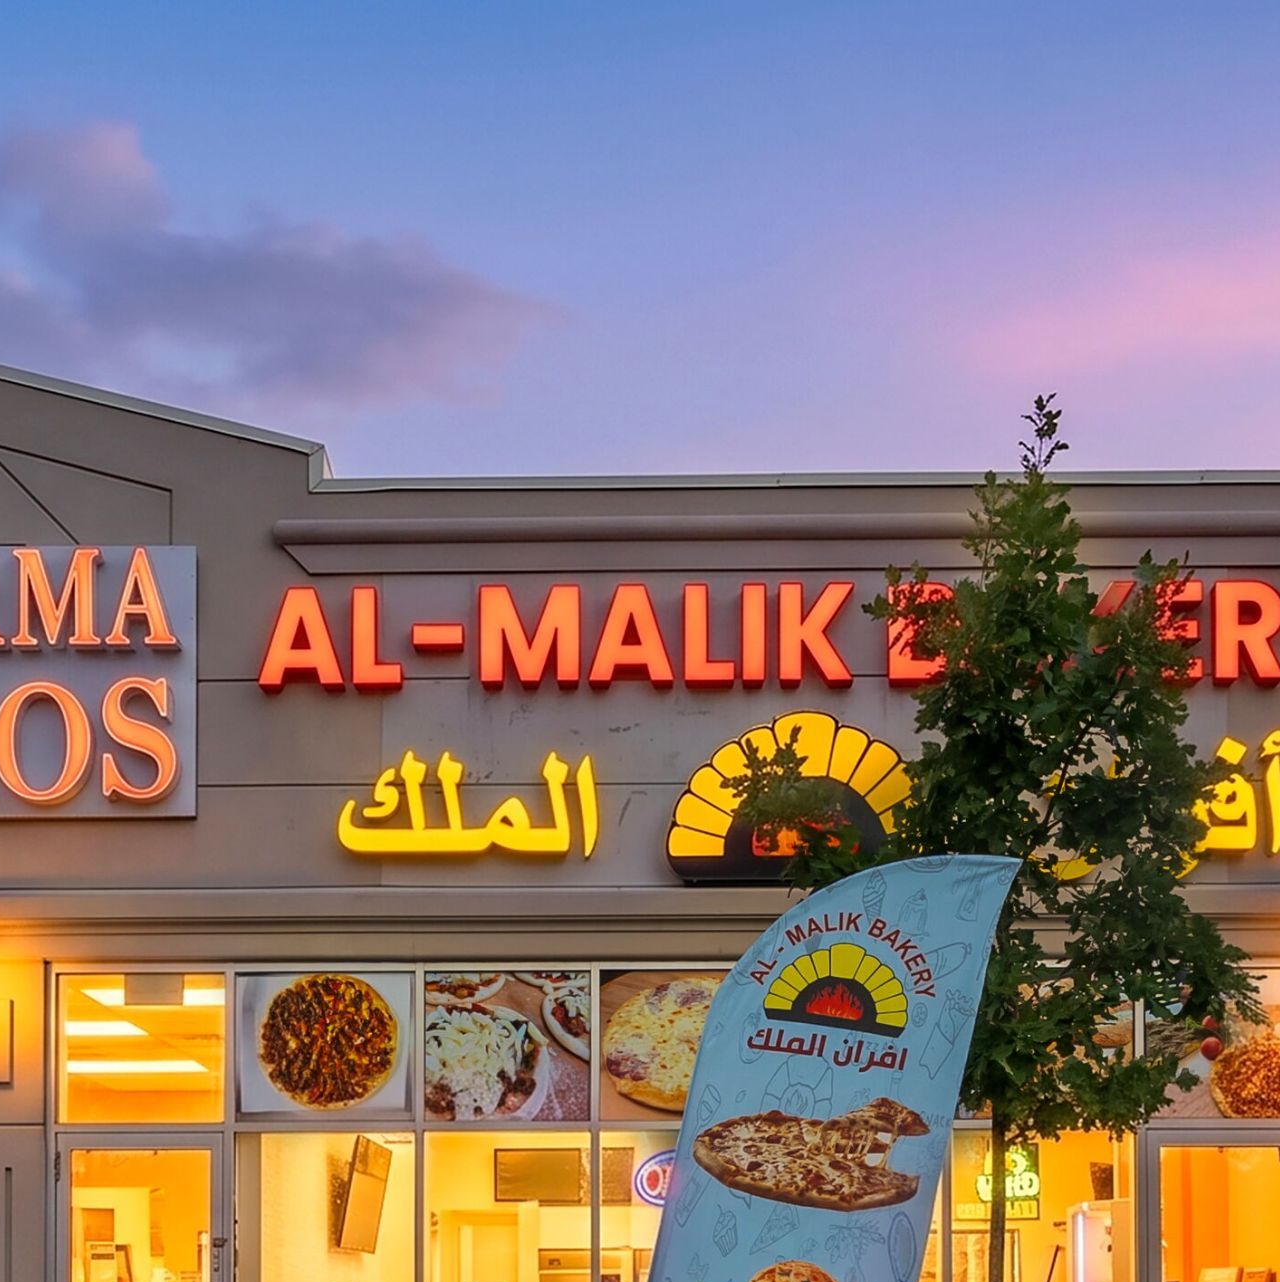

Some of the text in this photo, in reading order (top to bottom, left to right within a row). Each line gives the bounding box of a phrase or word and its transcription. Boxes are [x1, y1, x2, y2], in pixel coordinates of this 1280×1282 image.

[257, 582, 854, 692] AL-MALIK
[337, 751, 599, 860] الملك
[749, 957, 778, 985] AL
[785, 912, 863, 946] MALIK
[869, 917, 937, 998] BAKERY
[747, 1027, 827, 1058] الملك
